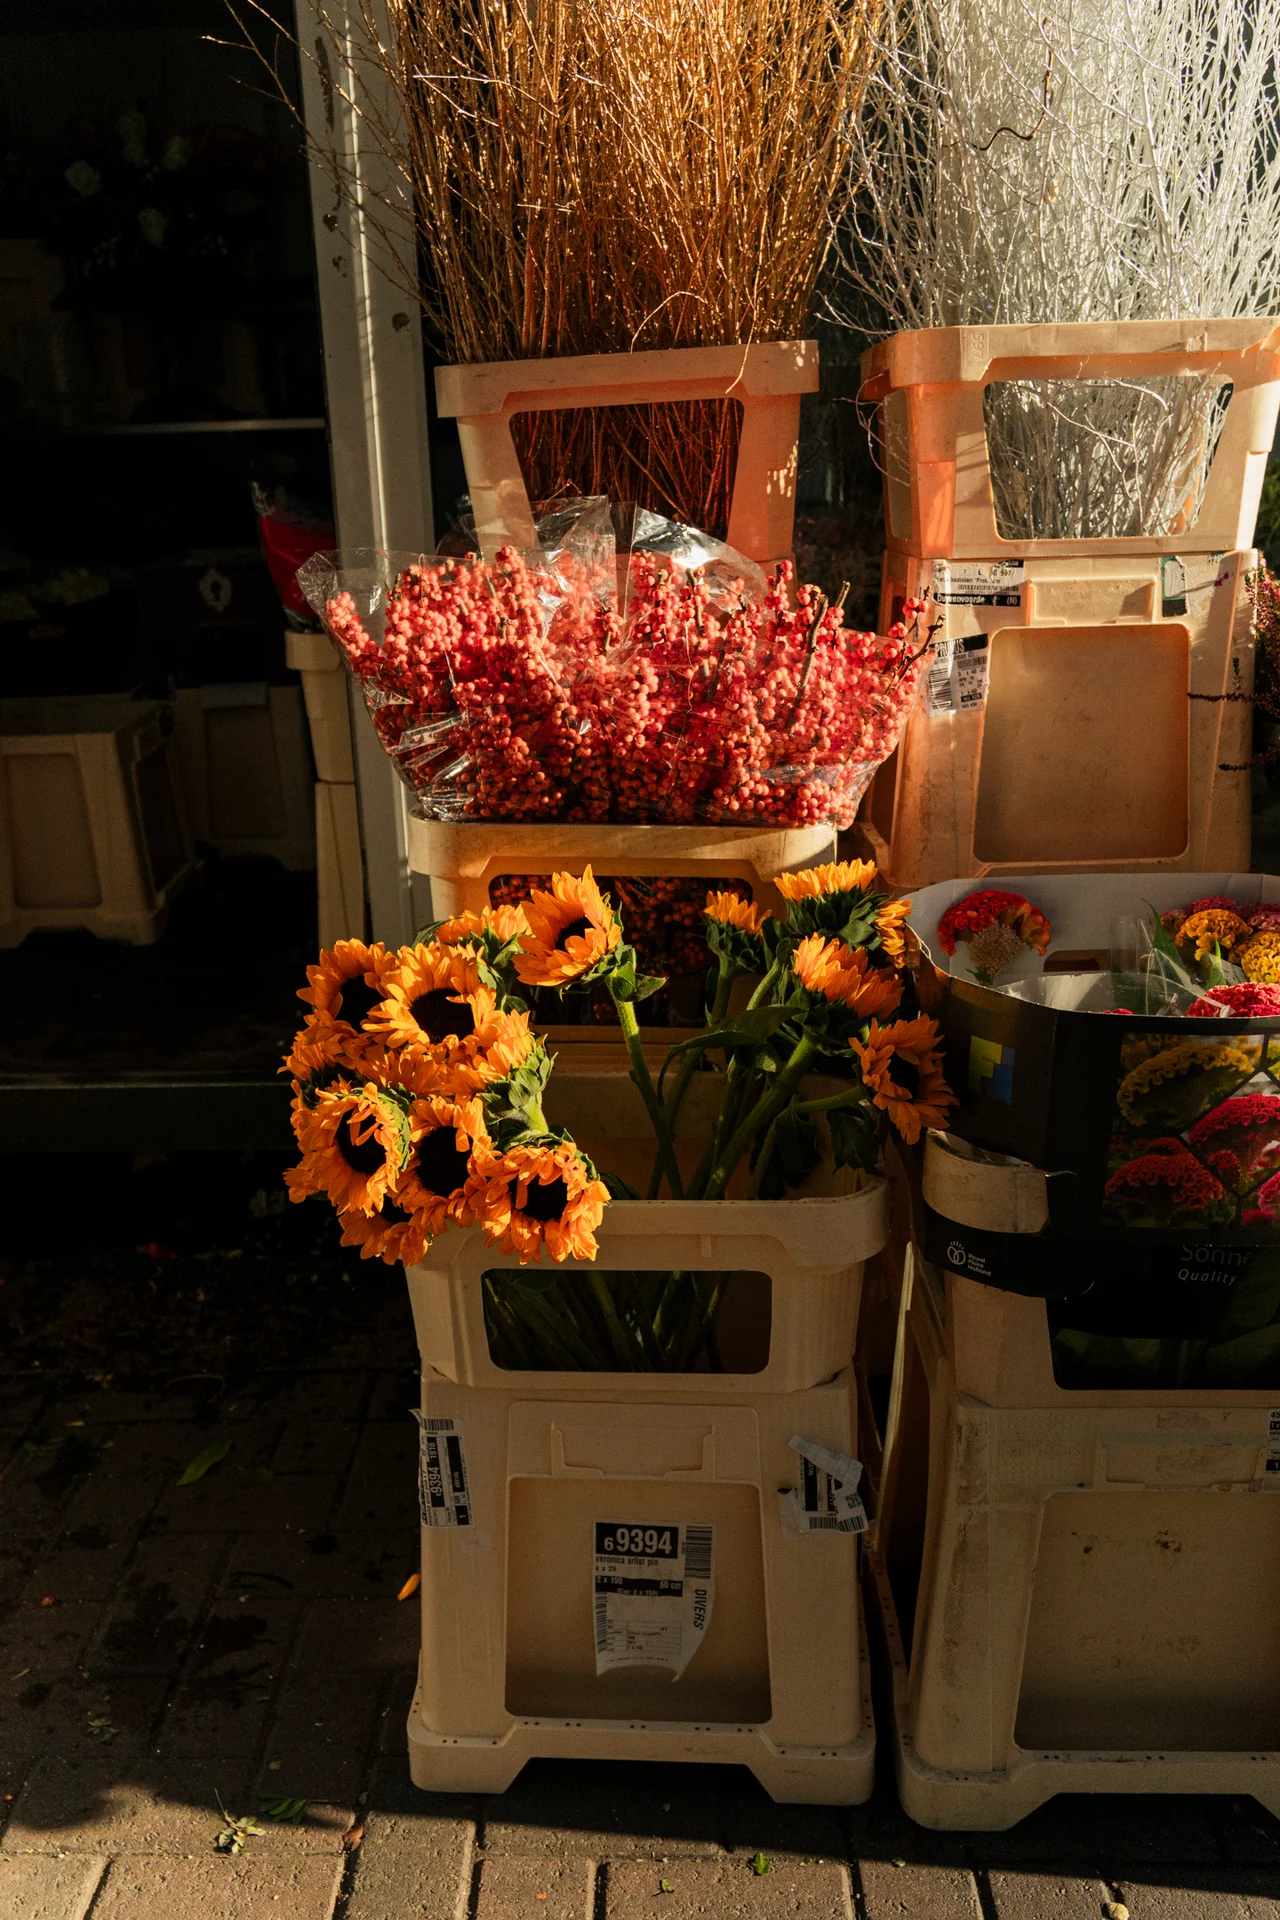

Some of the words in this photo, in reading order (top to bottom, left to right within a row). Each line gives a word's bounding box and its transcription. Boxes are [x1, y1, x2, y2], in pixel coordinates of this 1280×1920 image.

[967, 1258, 985, 1269] Flora
[968, 1253, 986, 1264] Royal
[967, 1264, 992, 1277] Holland
[1177, 1268, 1237, 1286] Quality
[428, 1442, 437, 1459] 1916
[595, 1555, 625, 1564] veronica
[659, 1580, 668, 1589] 60
[670, 1582, 682, 1590] cm
[692, 1588, 707, 1630] DIVERS
